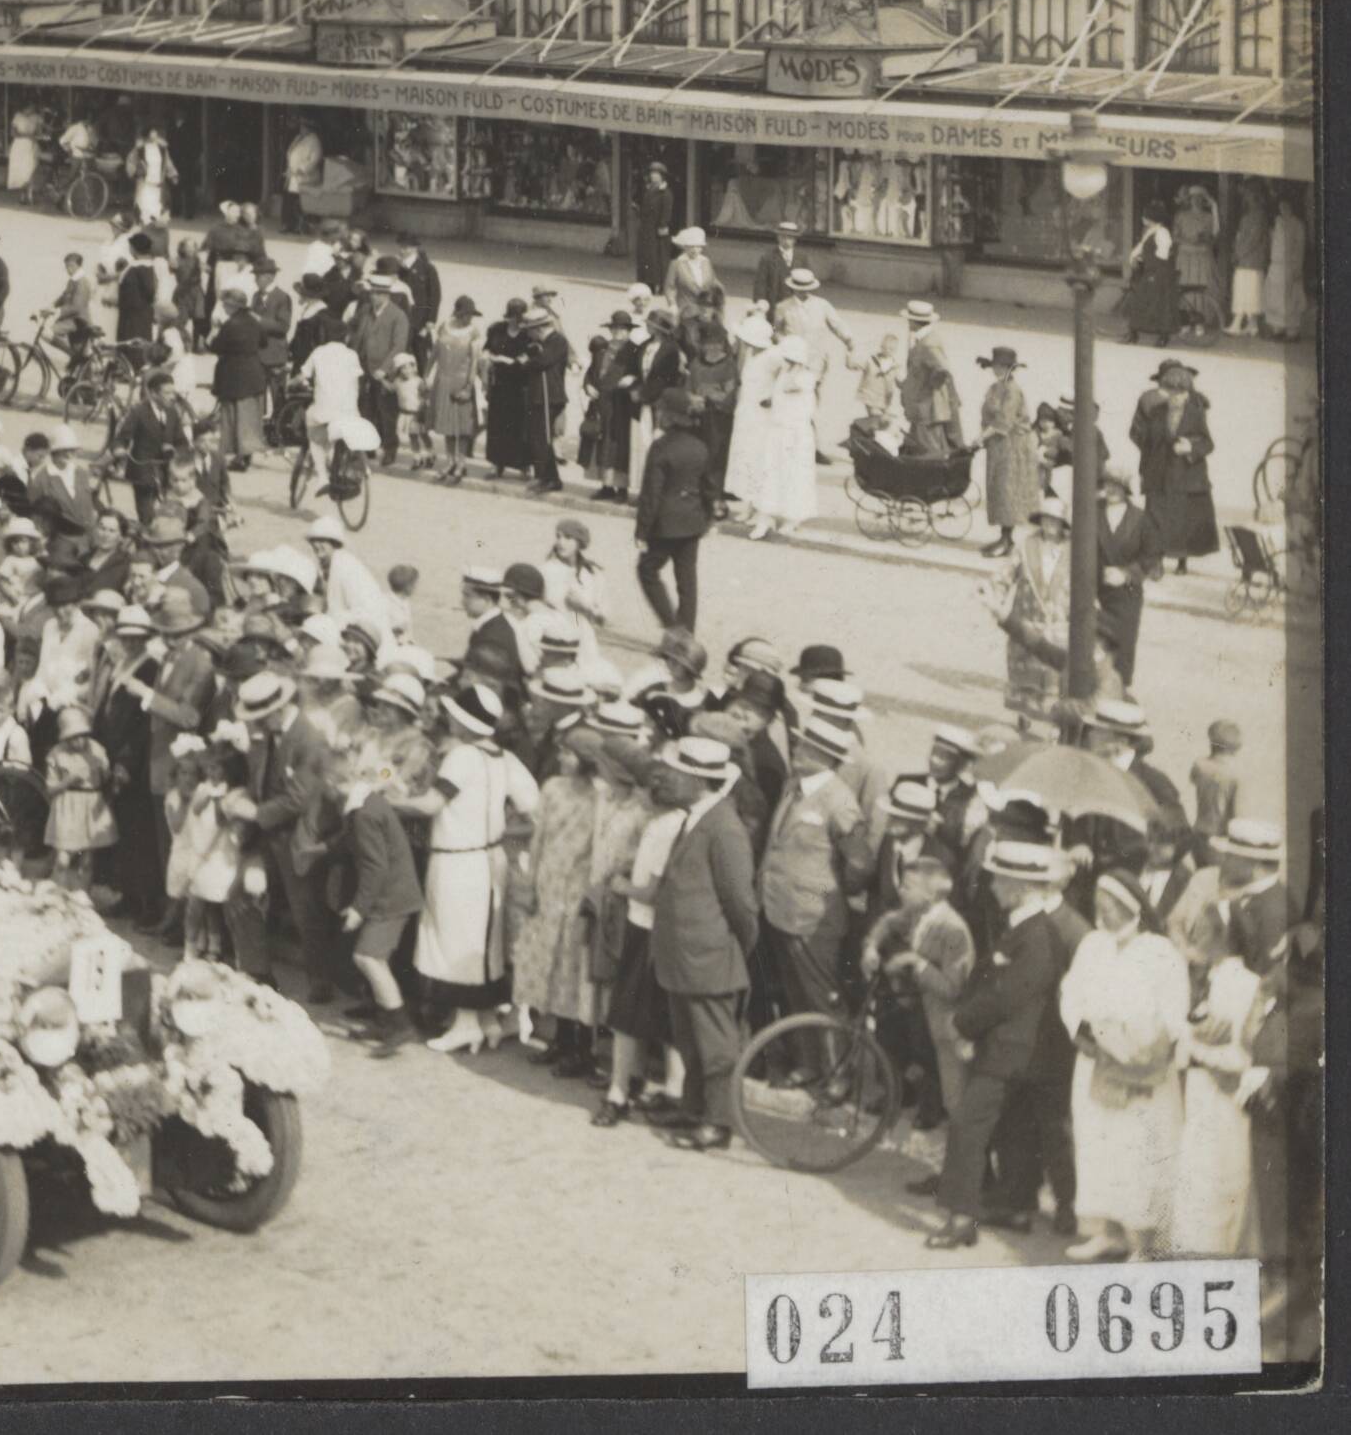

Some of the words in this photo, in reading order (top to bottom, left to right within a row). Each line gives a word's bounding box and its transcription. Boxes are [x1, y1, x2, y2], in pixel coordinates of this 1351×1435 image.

[776, 54, 861, 88] MODES
[96, 65, 164, 87] COSTUMES
[166, 71, 182, 88] DE
[186, 73, 217, 90] BAIN
[229, 76, 281, 95] MAISON
[286, 79, 317, 97] FULD
[331, 81, 380, 100] MODES
[395, 86, 458, 107] MAISON
[463, 91, 504, 111] FULD
[520, 94, 609, 121] COSTUMES
[612, 103, 632, 122] DE
[635, 105, 673, 126] BAIN
[689, 112, 758, 134] MAISON
[764, 116, 808, 138] FULD
[827, 119, 890, 142] MODES
[931, 124, 1003, 148] DAMES
[1013, 134, 1031, 150] ET
[1038, 130, 1177, 160] MEURS
